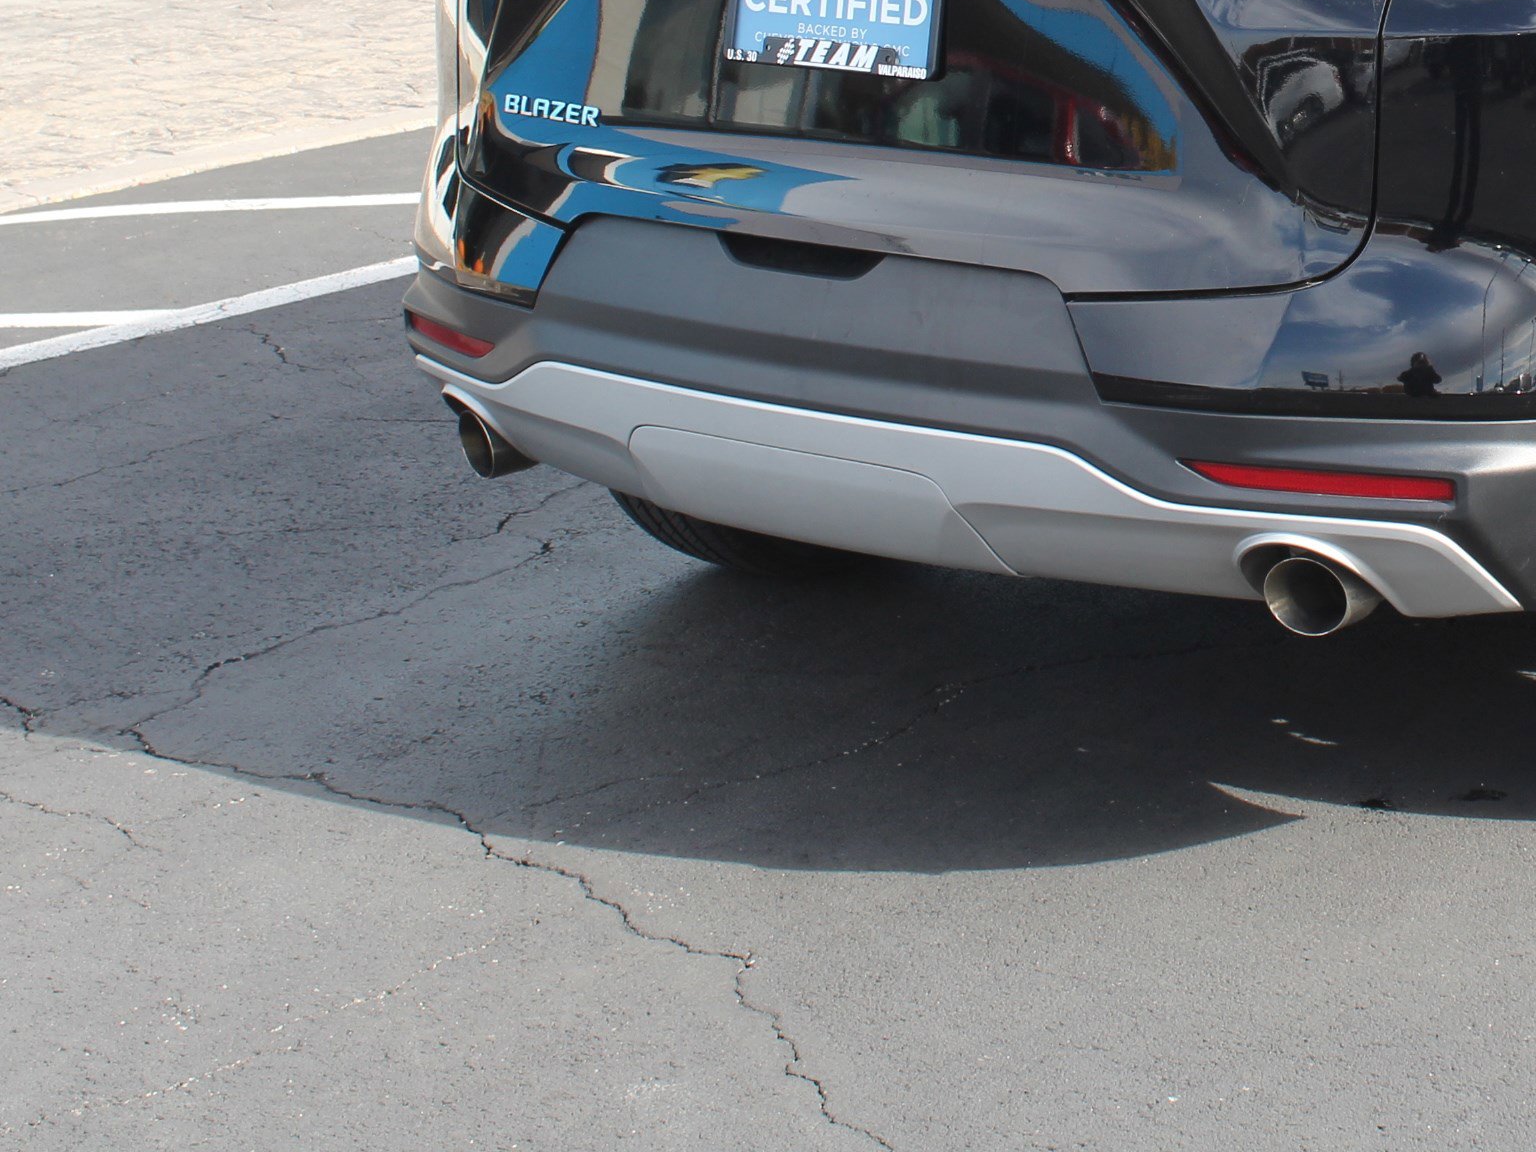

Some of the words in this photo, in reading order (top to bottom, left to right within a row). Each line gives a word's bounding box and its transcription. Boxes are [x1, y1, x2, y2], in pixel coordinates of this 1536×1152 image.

[797, 22, 847, 38] BACKED
[851, 27, 868, 40] BY
[726, 48, 744, 61] U.S.
[746, 50, 758, 63] 30
[794, 38, 879, 69] TEAM
[878, 63, 928, 80] VALPARAISO
[504, 93, 599, 127] BLAZER
